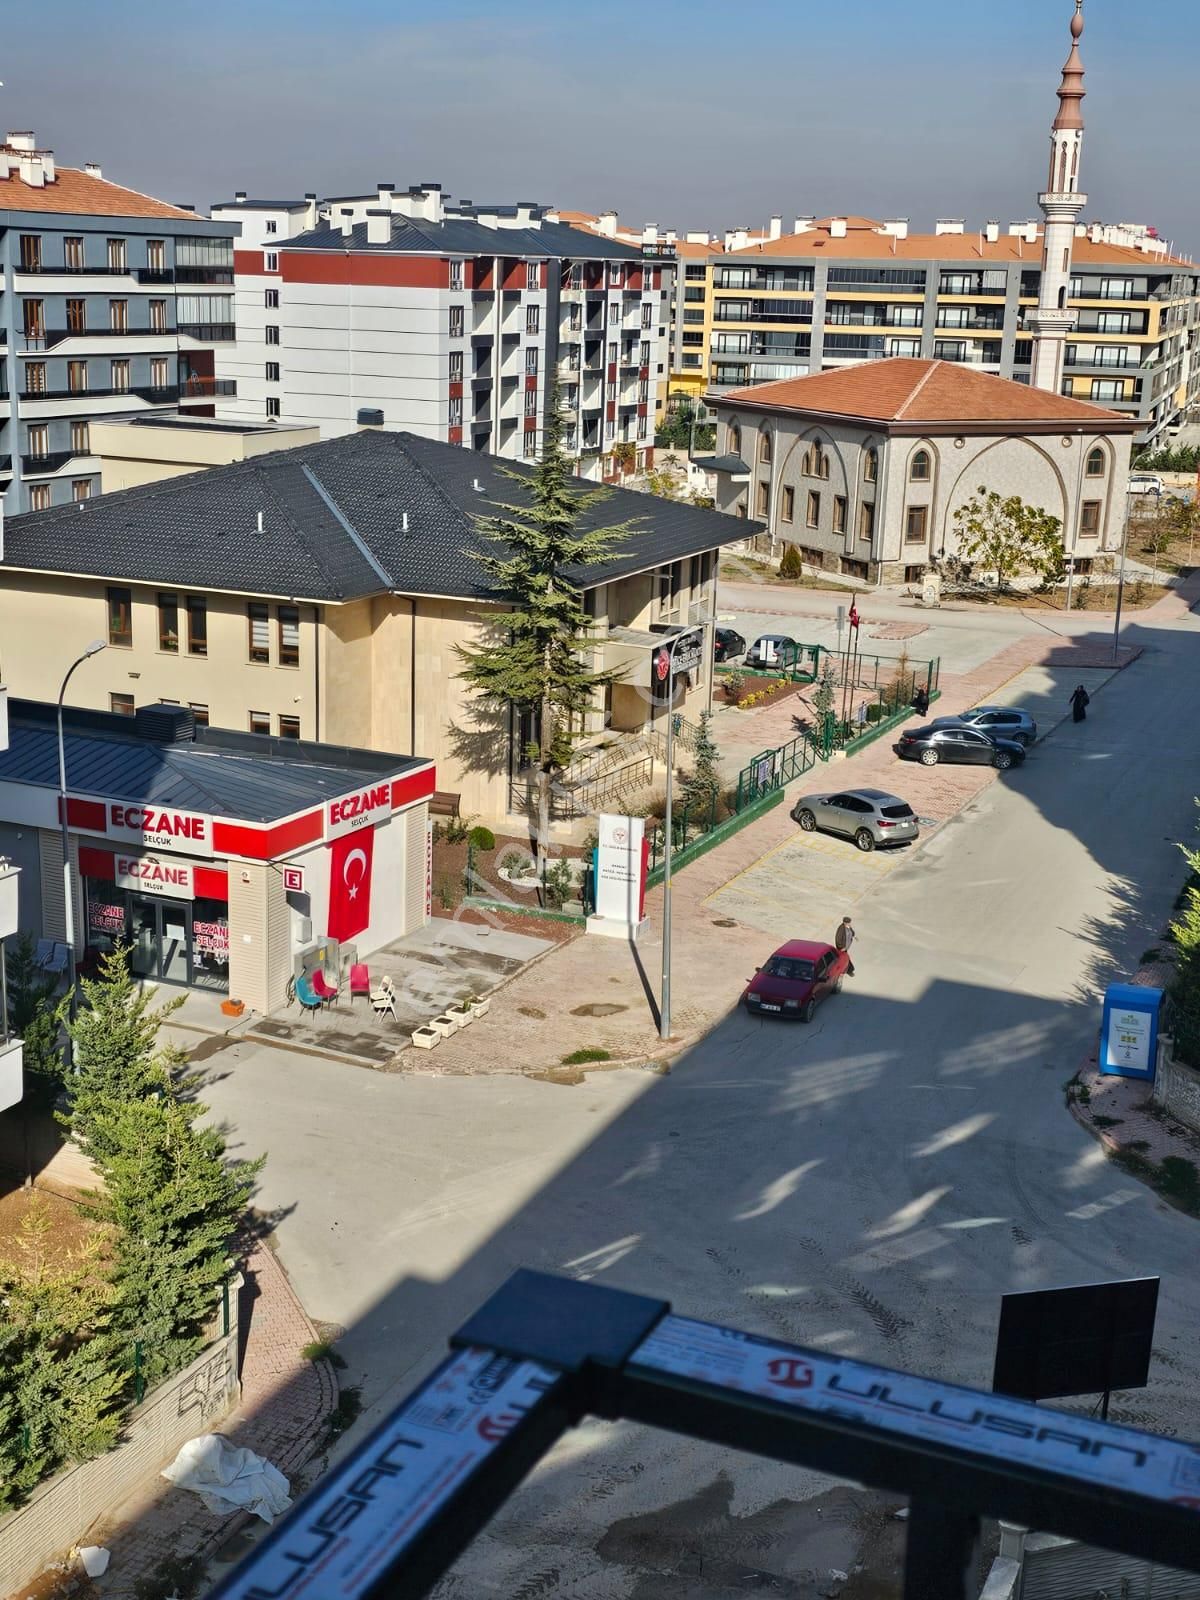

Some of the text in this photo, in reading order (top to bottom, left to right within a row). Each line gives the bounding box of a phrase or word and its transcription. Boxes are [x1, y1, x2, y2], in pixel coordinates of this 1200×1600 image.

[330, 784, 390, 825] ECZANE
[112, 805, 204, 840] ECZANE
[143, 834, 171, 846] SELÇUK
[118, 860, 188, 886] ECZANE
[827, 1372, 1147, 1467] ULUSAN
